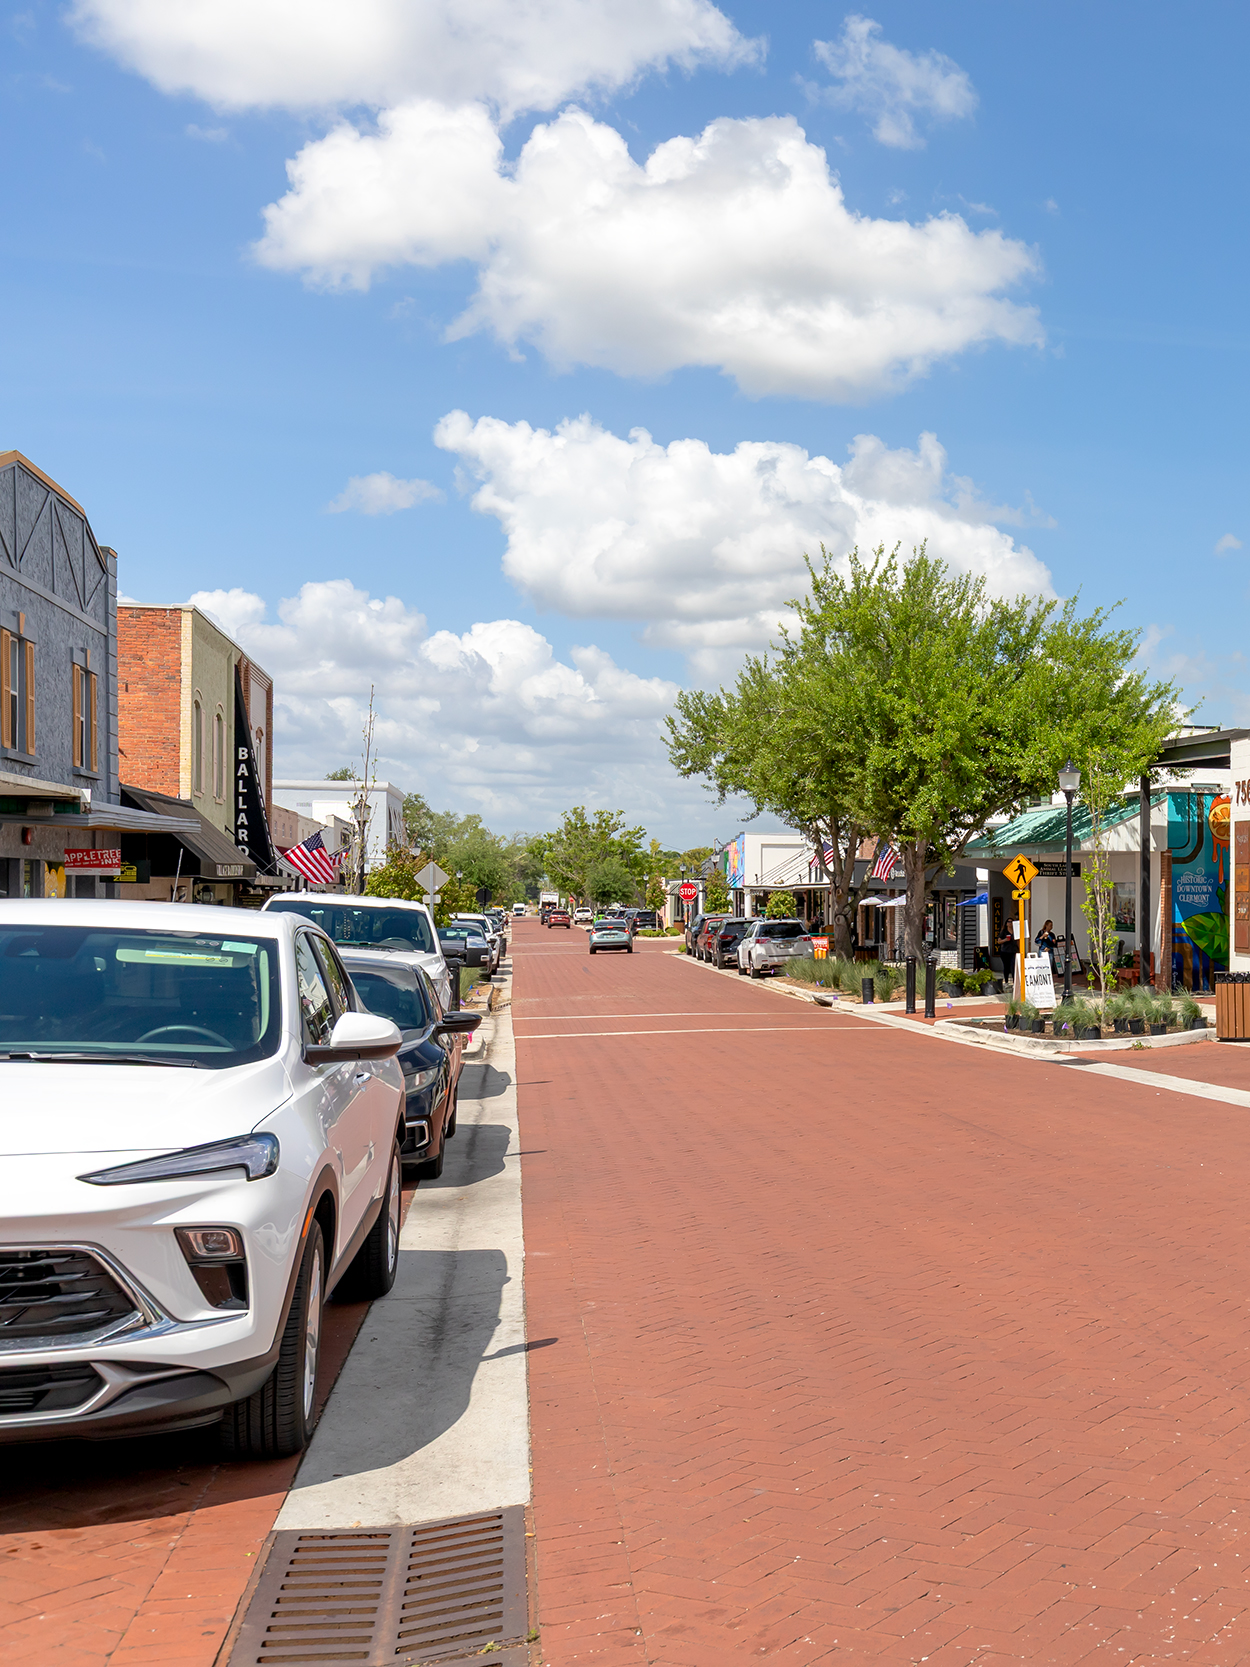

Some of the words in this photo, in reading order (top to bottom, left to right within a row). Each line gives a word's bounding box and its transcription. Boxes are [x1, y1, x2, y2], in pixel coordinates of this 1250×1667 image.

[237, 747, 249, 857] BALLARD
[64, 850, 121, 863] APPLETREE
[1179, 875, 1208, 884] HISTORIC
[680, 888, 696, 896] STOP
[1176, 885, 1213, 893] DOWNTOWN
[1178, 893, 1210, 902] CLERMONT
[1024, 973, 1052, 987] EAMONT
